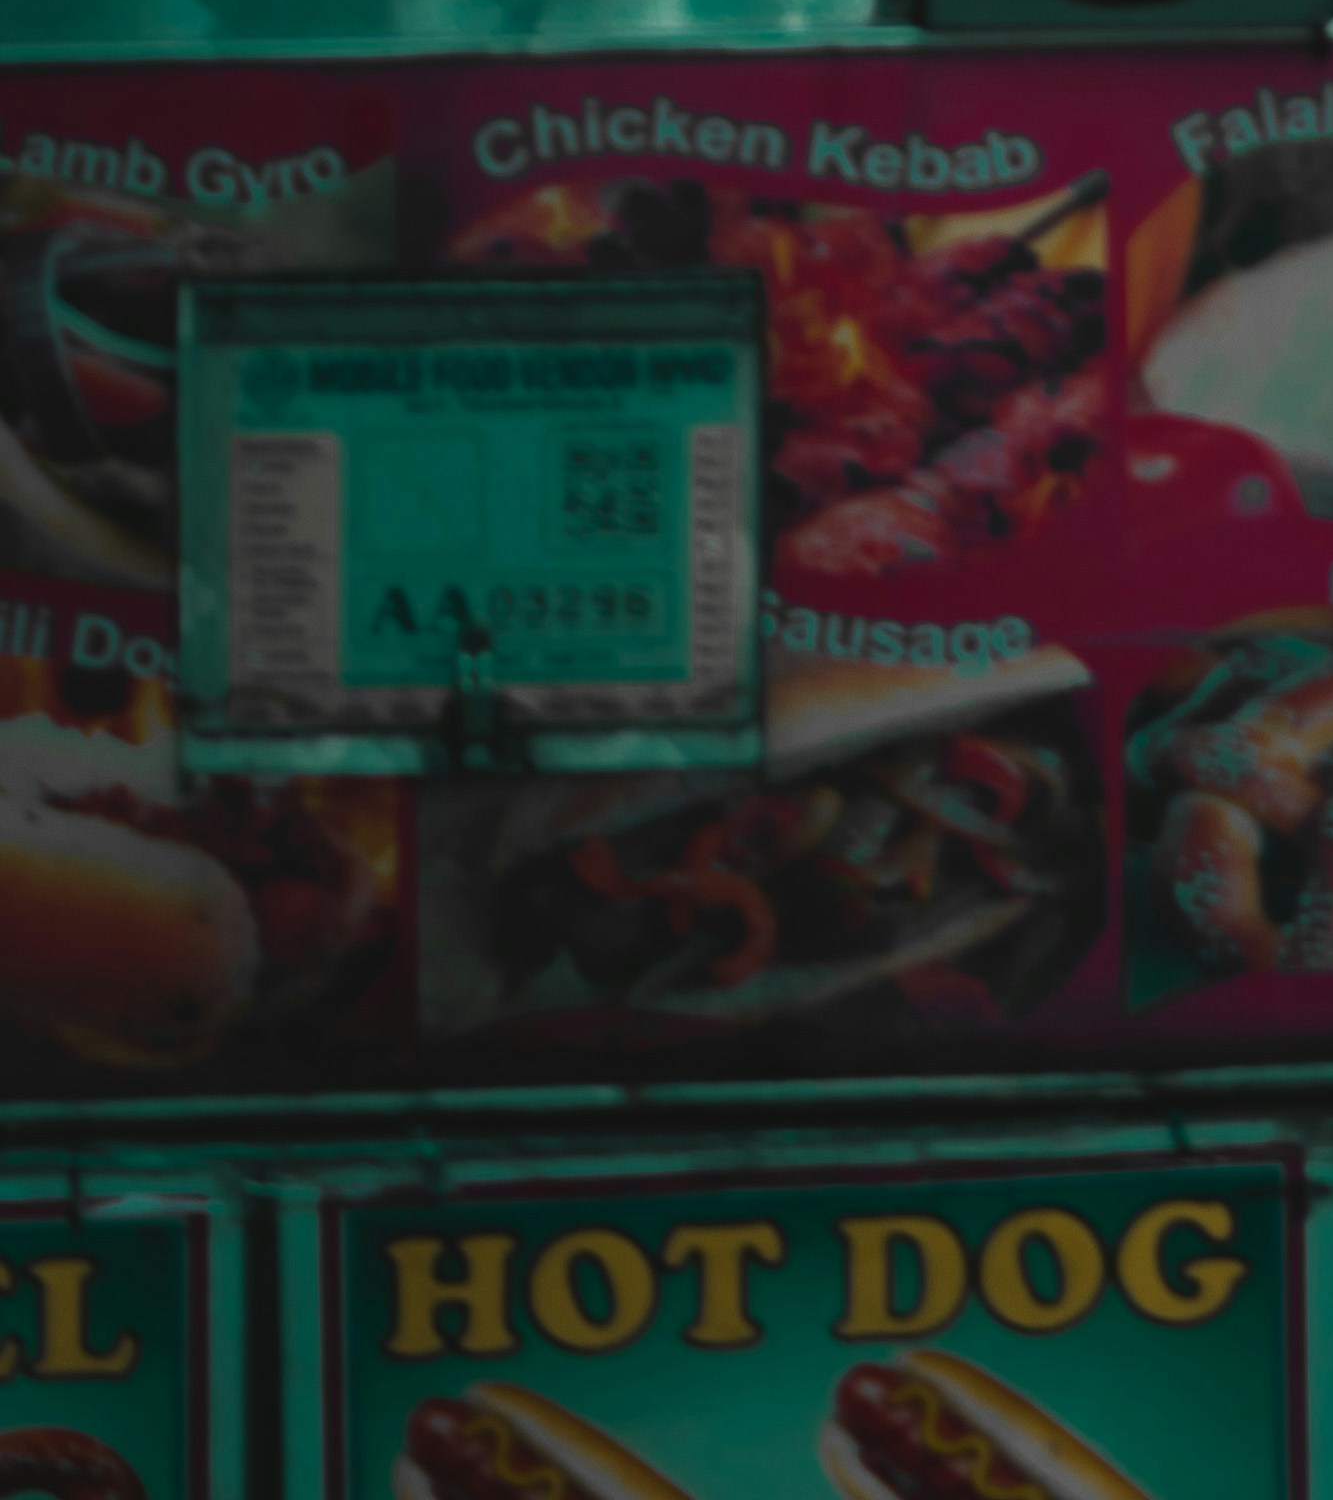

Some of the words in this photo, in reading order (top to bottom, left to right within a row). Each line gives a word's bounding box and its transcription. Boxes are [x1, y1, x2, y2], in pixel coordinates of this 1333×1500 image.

[0, 131, 167, 198] amb
[185, 145, 350, 222] Gyro
[472, 100, 786, 180] Chicken
[806, 120, 1046, 190] Kebab
[378, 1212, 790, 1362] HOT
[832, 1198, 1256, 1343] DOG
